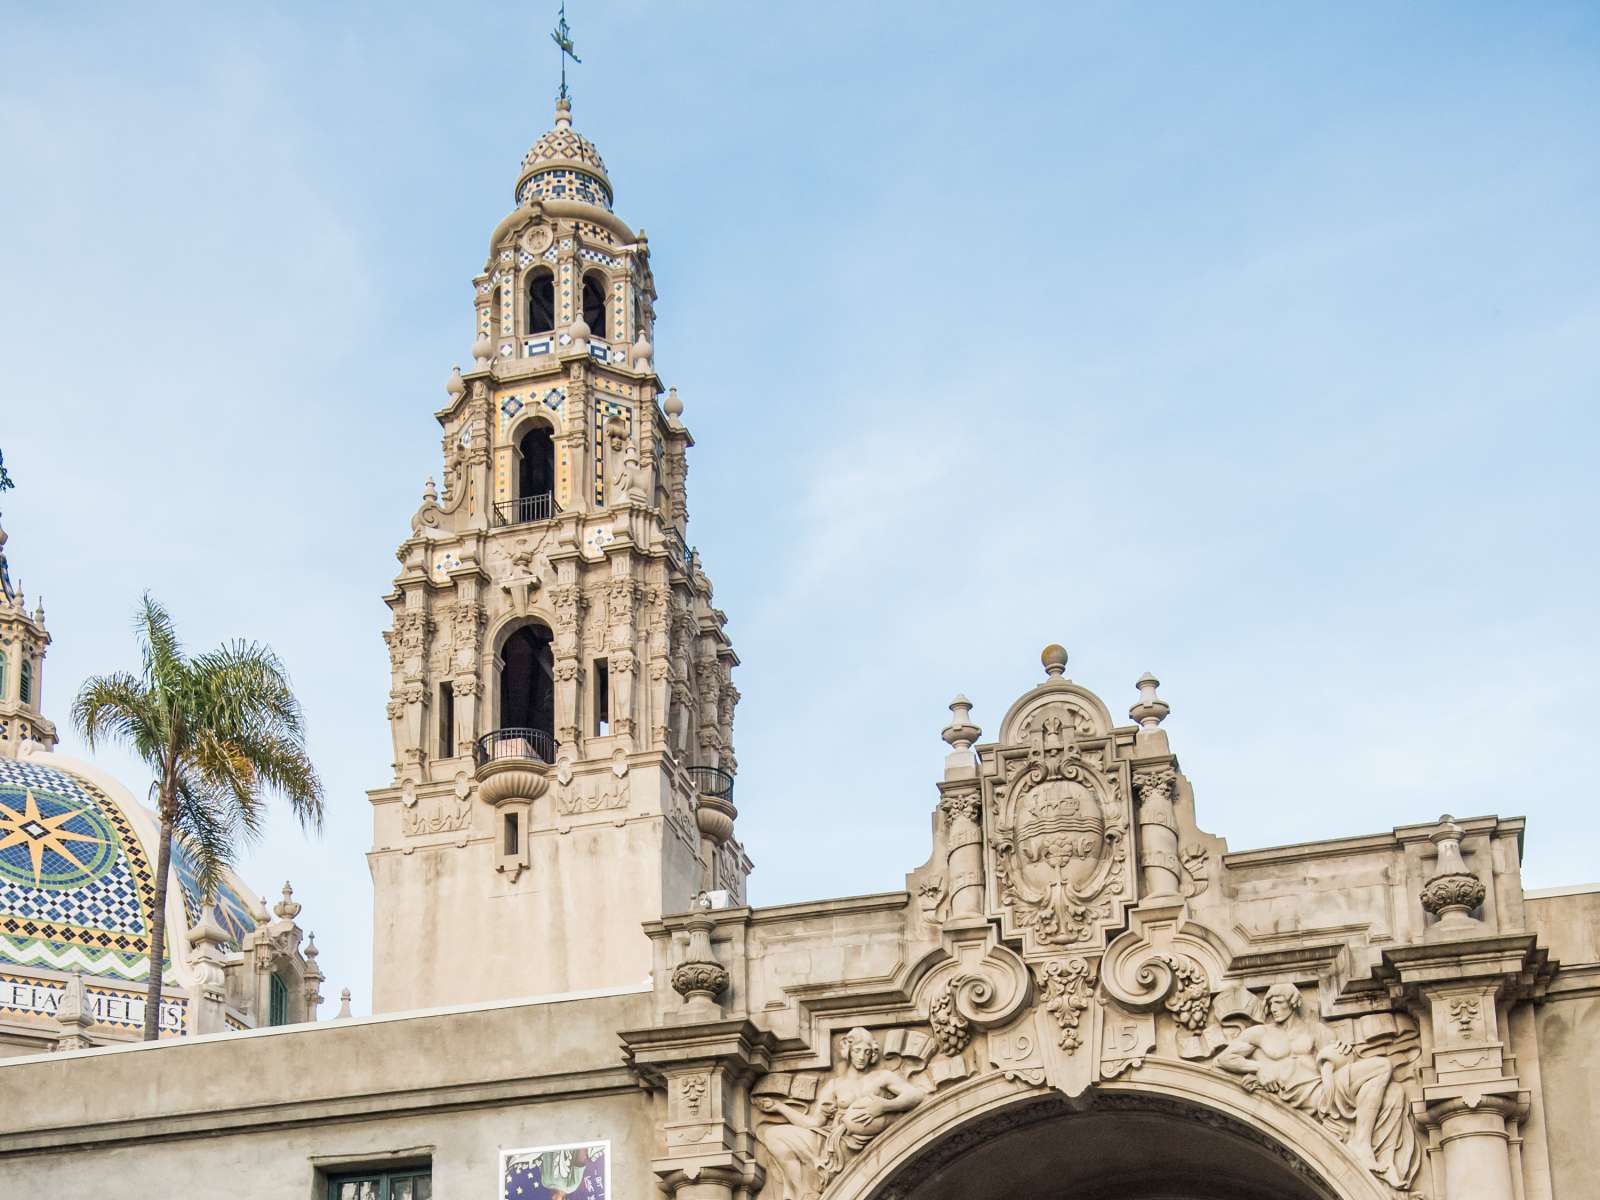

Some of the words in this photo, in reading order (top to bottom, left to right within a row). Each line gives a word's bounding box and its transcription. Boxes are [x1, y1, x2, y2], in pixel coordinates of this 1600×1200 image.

[92, 998, 178, 1026] ELIS
[1003, 1034, 1033, 1061] 19
[1107, 1023, 1138, 1052] 15
